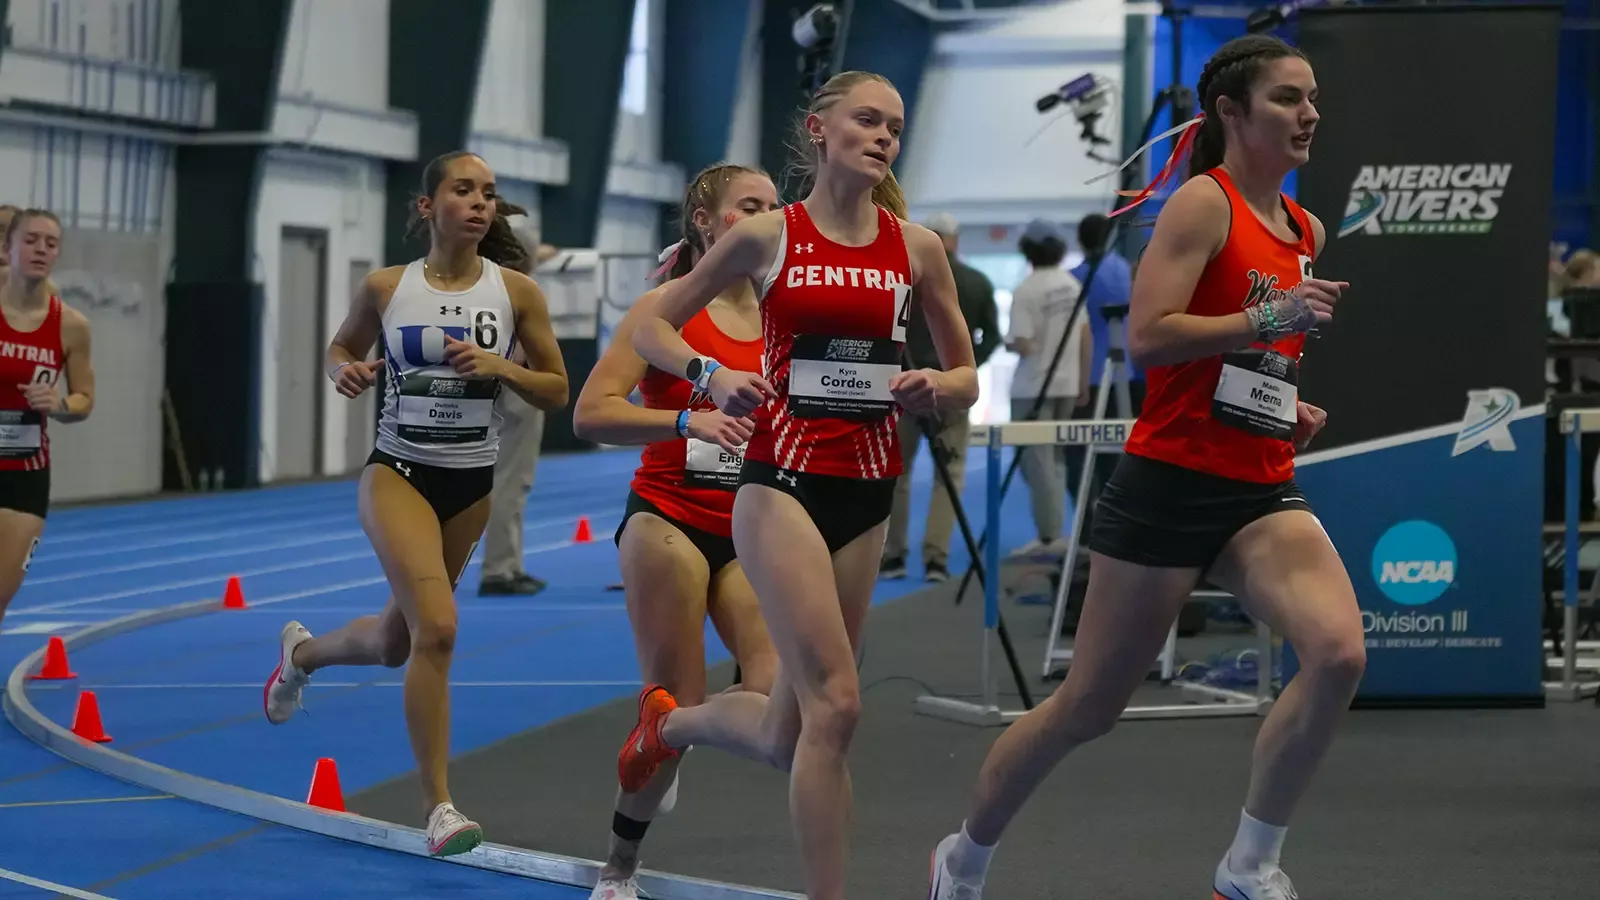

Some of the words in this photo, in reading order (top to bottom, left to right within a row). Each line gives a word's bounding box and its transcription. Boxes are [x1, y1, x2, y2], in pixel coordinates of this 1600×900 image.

[1351, 164, 1513, 190] AMERICAN
[1337, 190, 1504, 239] RIVERS
[1386, 223, 1489, 234] CONFERENCE
[475, 310, 498, 349] 6
[829, 339, 874, 348] AMERICAN
[839, 368, 857, 376] Kyra
[821, 375, 872, 389] Cordes
[429, 408, 463, 419] Davis
[1056, 424, 1125, 442] LUTHER
[1380, 560, 1454, 583] NCAA
[1360, 610, 1445, 633] Division
[1452, 610, 1468, 632] III
[1385, 637, 1439, 648] DEVELOP
[1445, 637, 1502, 648] DEDICATE
